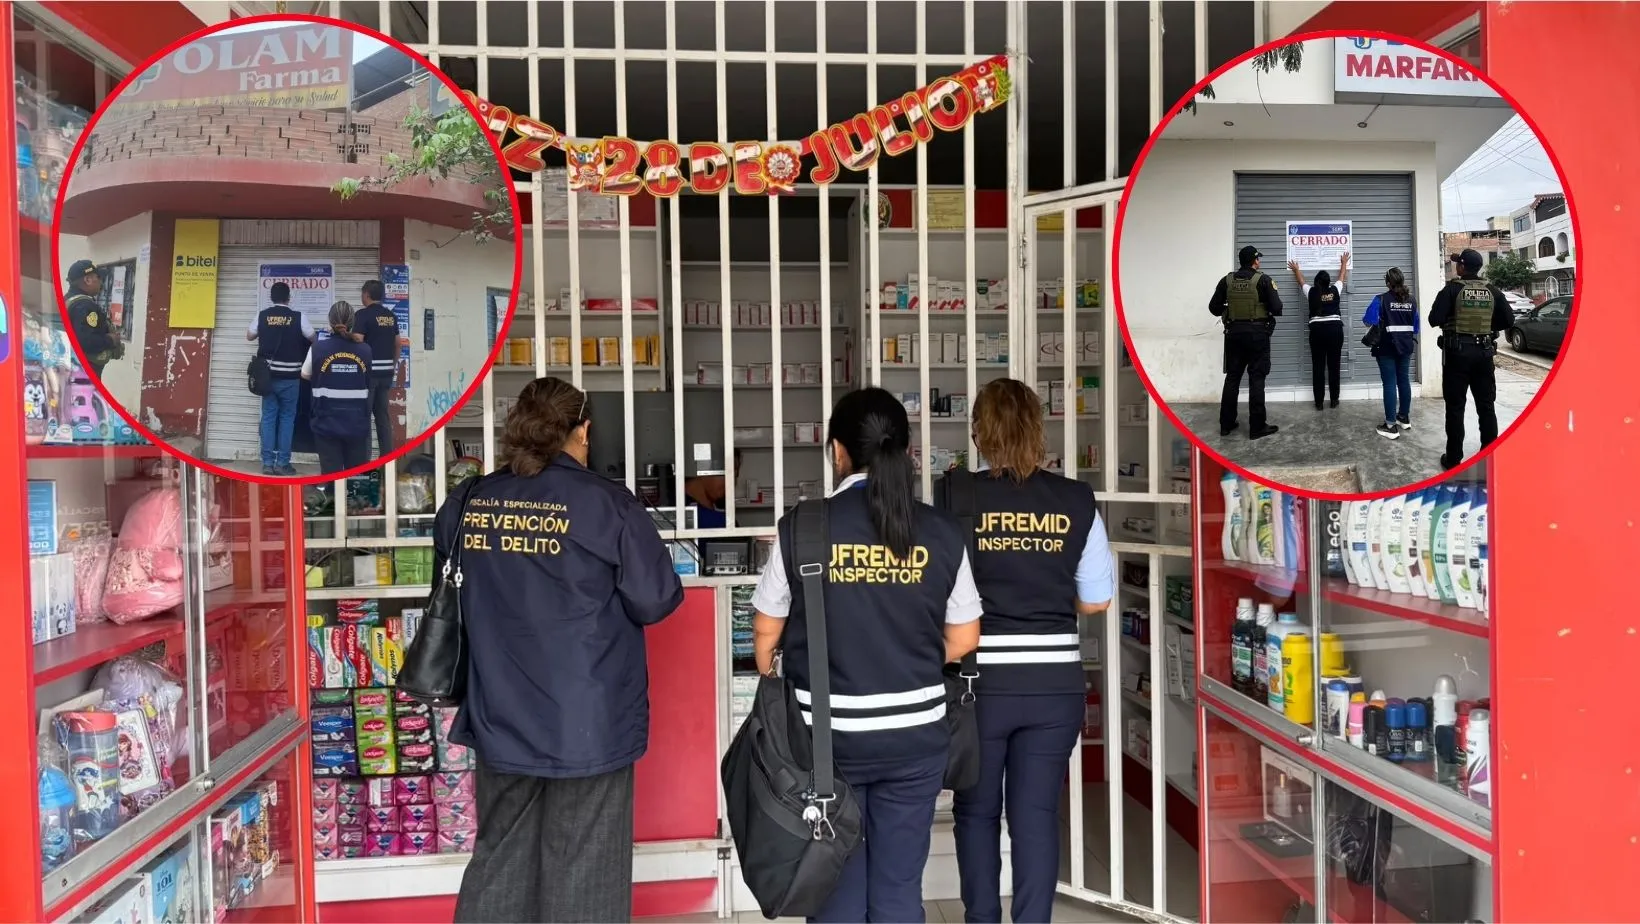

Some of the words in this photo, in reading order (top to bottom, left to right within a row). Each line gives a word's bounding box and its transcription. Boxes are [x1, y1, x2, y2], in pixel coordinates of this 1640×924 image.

[172, 27, 343, 75] OLAM
[239, 66, 342, 92] Farma
[1346, 53, 1480, 81] MARFAR
[309, 88, 339, 104] Salud
[600, 136, 686, 198] 28
[689, 142, 770, 196] DE
[808, 76, 976, 186] JULIO
[1291, 235, 1348, 246] CERRADO
[186, 255, 216, 267] bitel
[1464, 289, 1490, 297] POLICIA
[503, 500, 568, 512] ESPECIALIZADA
[462, 511, 570, 534] PREVENCIÓN
[1326, 510, 1341, 548] eGo
[463, 534, 492, 551] DEL
[500, 536, 561, 555] DELITO
[978, 536, 1064, 553] INSPECTOR
[828, 567, 923, 584] INSPECTOR
[346, 624, 356, 660] Colgate
[309, 651, 317, 687] Colgate
[359, 653, 367, 685] Colgate
[388, 649, 398, 680] Kolynos
